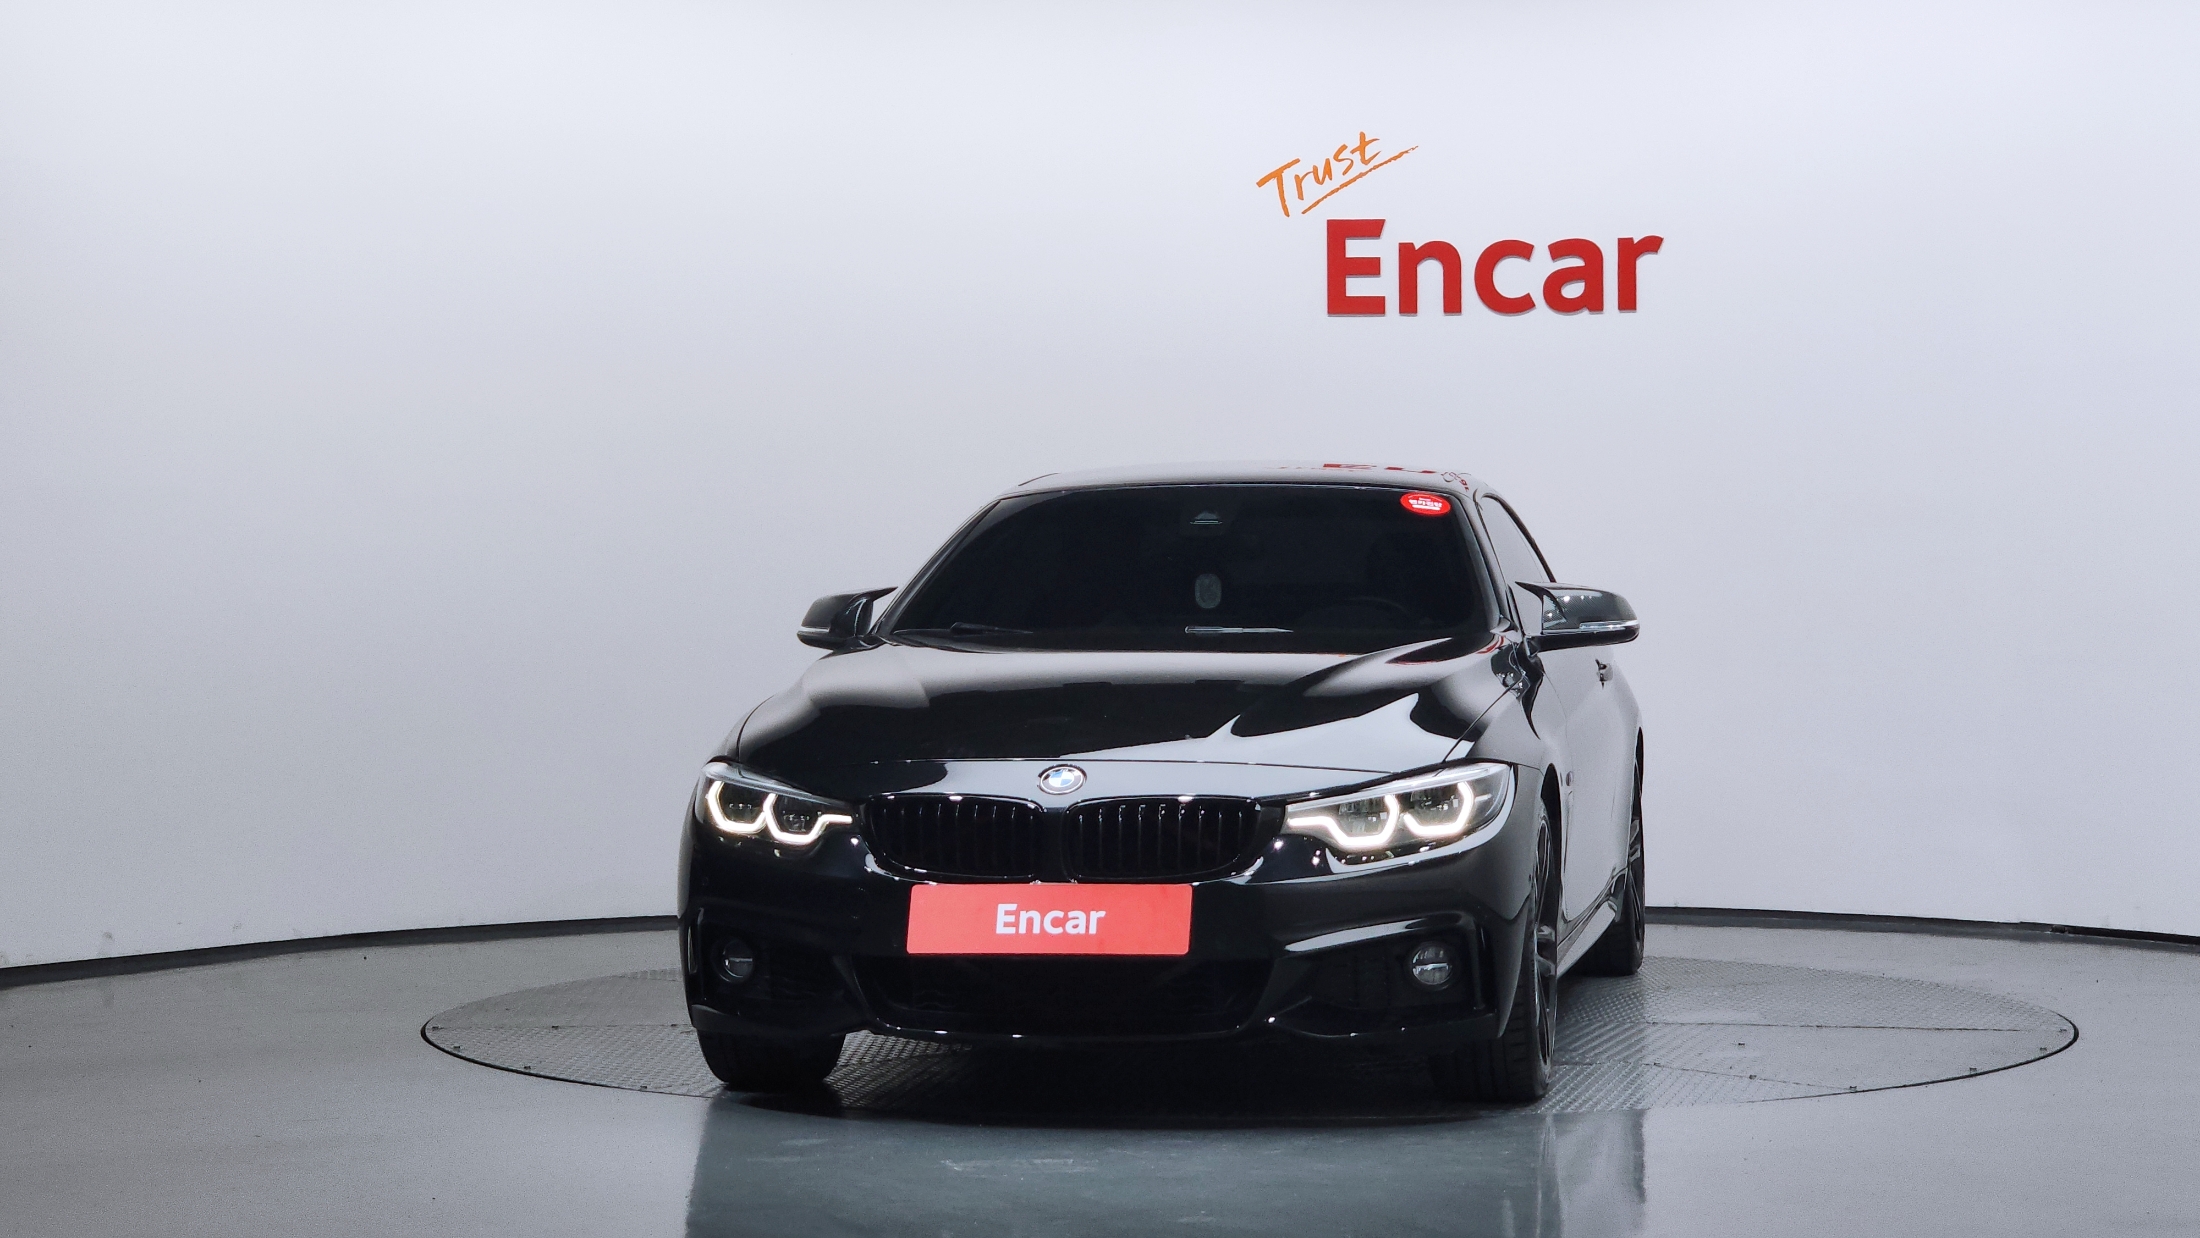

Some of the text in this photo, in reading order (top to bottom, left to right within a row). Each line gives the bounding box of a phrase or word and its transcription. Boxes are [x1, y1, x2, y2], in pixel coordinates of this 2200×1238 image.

[1256, 131, 1380, 217] Trust
[1327, 219, 1664, 316] Encar
[995, 903, 1106, 935] Encar
